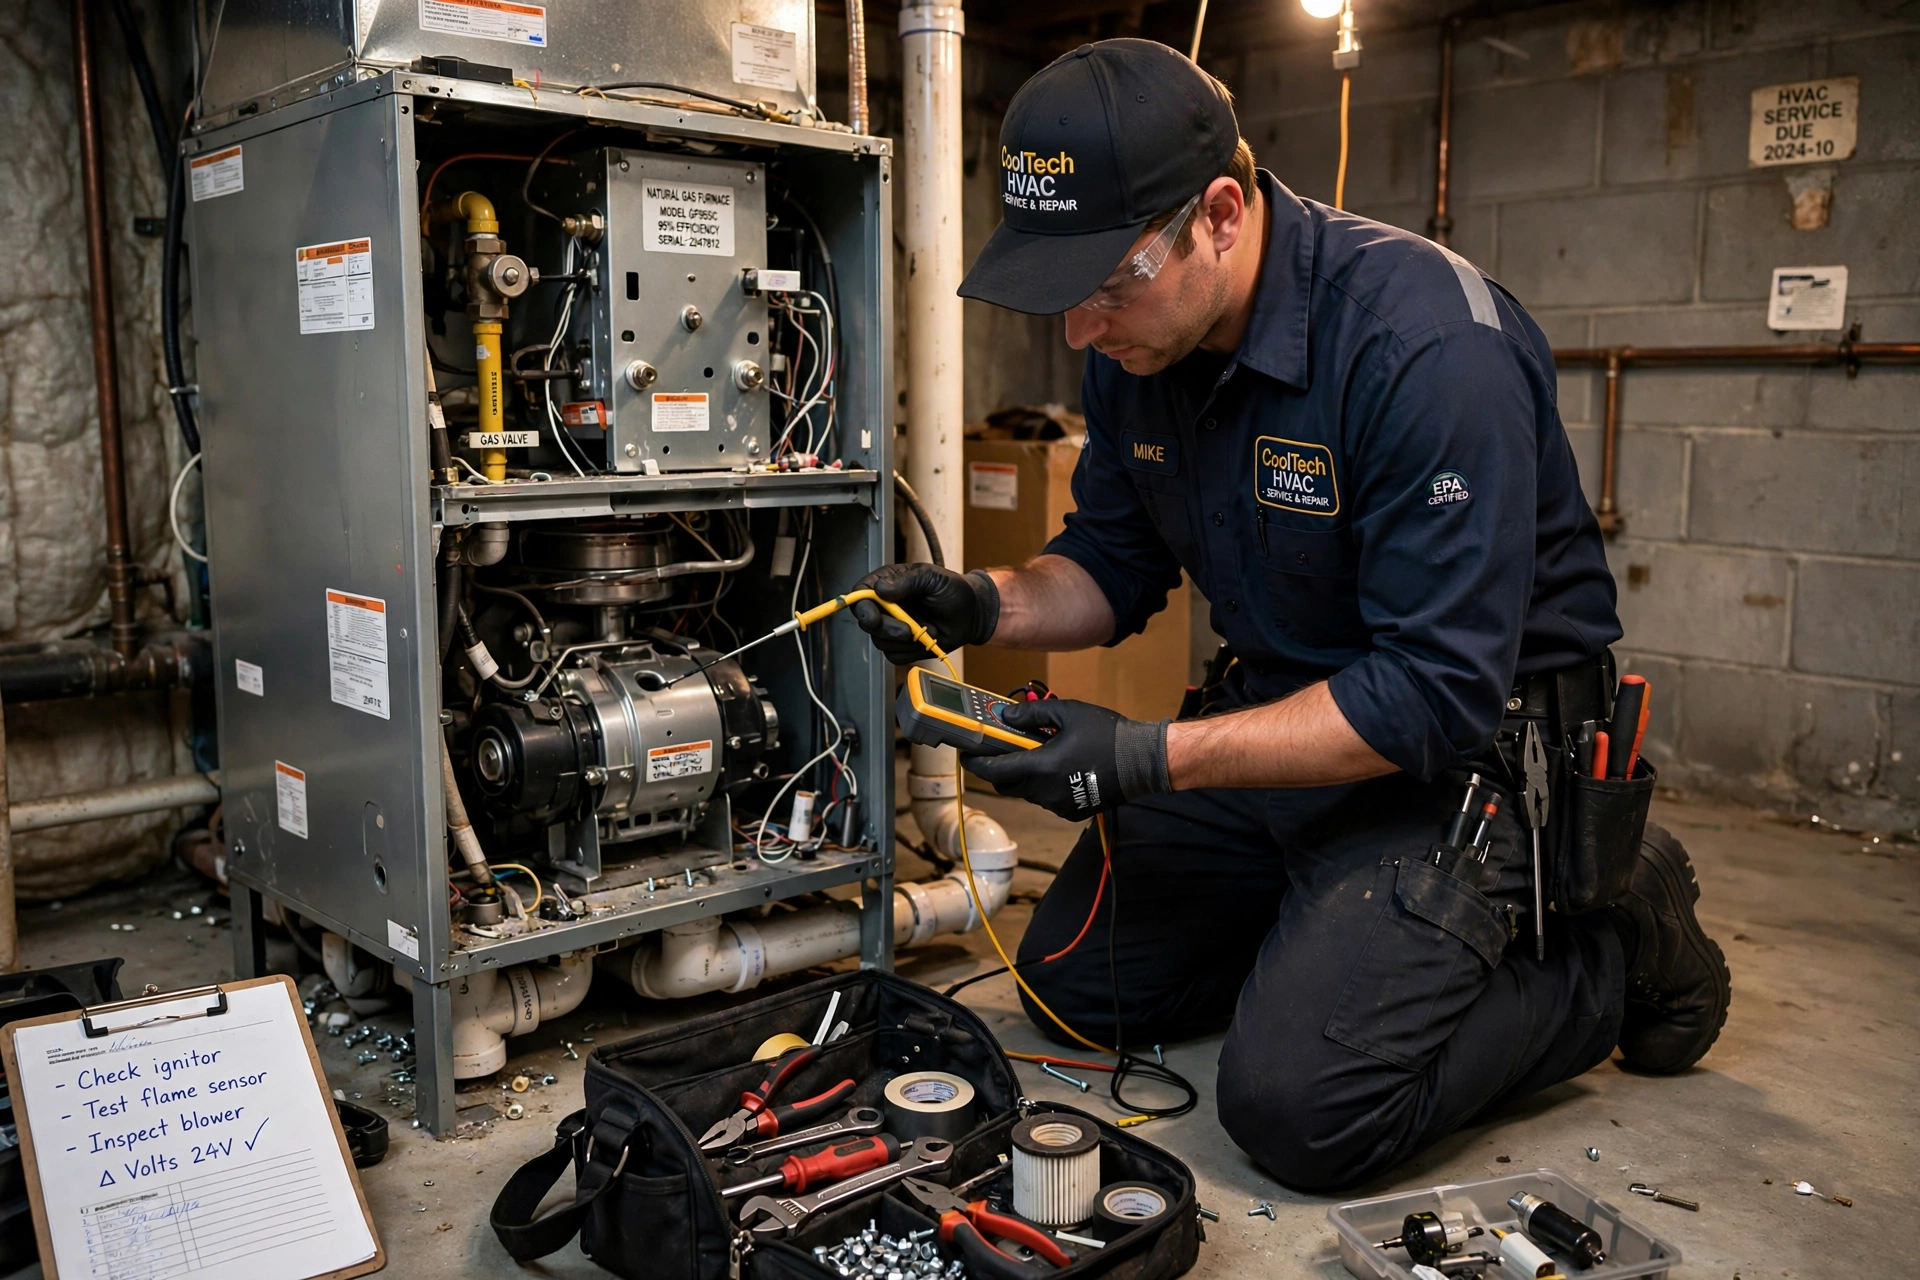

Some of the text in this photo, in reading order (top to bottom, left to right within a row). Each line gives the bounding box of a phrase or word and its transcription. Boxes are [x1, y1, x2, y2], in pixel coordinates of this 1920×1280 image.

[1778, 85, 1828, 105] HVAC
[1764, 101, 1842, 125] SERVICE
[1776, 122, 1813, 141] DUE
[1001, 145, 1074, 174] CoolTech
[1764, 140, 1834, 160] 2024-10
[1007, 171, 1056, 196] HVAC
[647, 187, 679, 201] NATURAL
[682, 191, 696, 202] GAS
[660, 206, 686, 218] MODEL
[1030, 199, 1036, 210] &
[1039, 199, 1077, 211] REPAIR
[677, 221, 719, 235] EFFICIENCY
[480, 433, 528, 445] GAS VALVE
[1133, 442, 1164, 462] MIKE
[1262, 448, 1326, 475] CoolTech
[1273, 469, 1314, 493] HVAC
[1433, 478, 1462, 495] EPA
[77, 1062, 141, 1089] Check
[153, 1049, 221, 1080] ignitor
[83, 1095, 129, 1119] Test
[141, 1086, 198, 1107] flame
[208, 1072, 267, 1093] sensor
[88, 1118, 169, 1154] Inspect
[180, 1106, 244, 1131] blower
[124, 1154, 178, 1179] Volts
[191, 1138, 233, 1164] 24V
